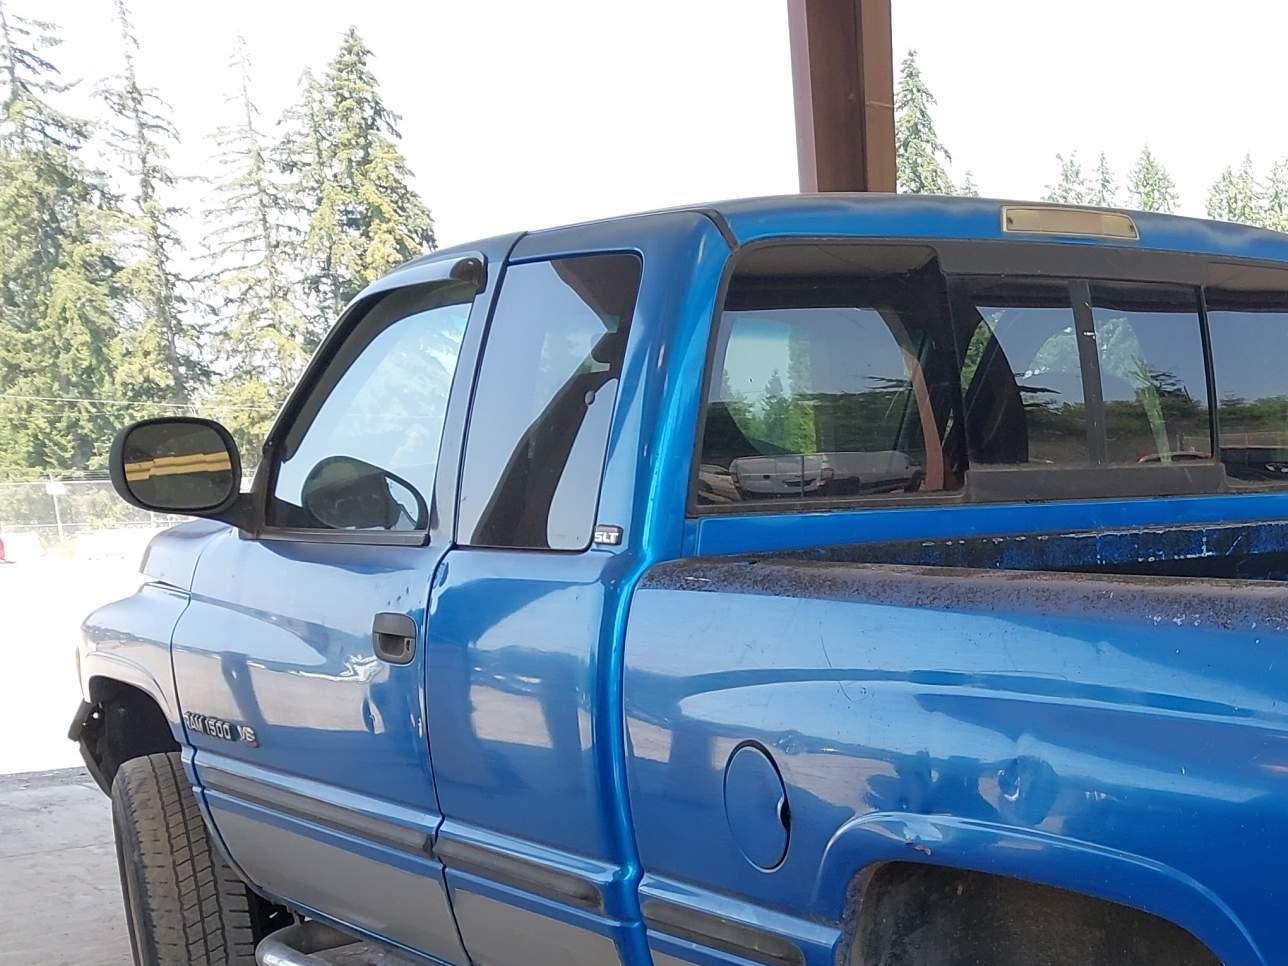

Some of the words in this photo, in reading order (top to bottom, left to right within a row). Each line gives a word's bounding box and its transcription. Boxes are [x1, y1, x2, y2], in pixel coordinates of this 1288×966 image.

[594, 531, 619, 545] SLT
[182, 713, 203, 732] RAM
[204, 717, 232, 740] 1500
